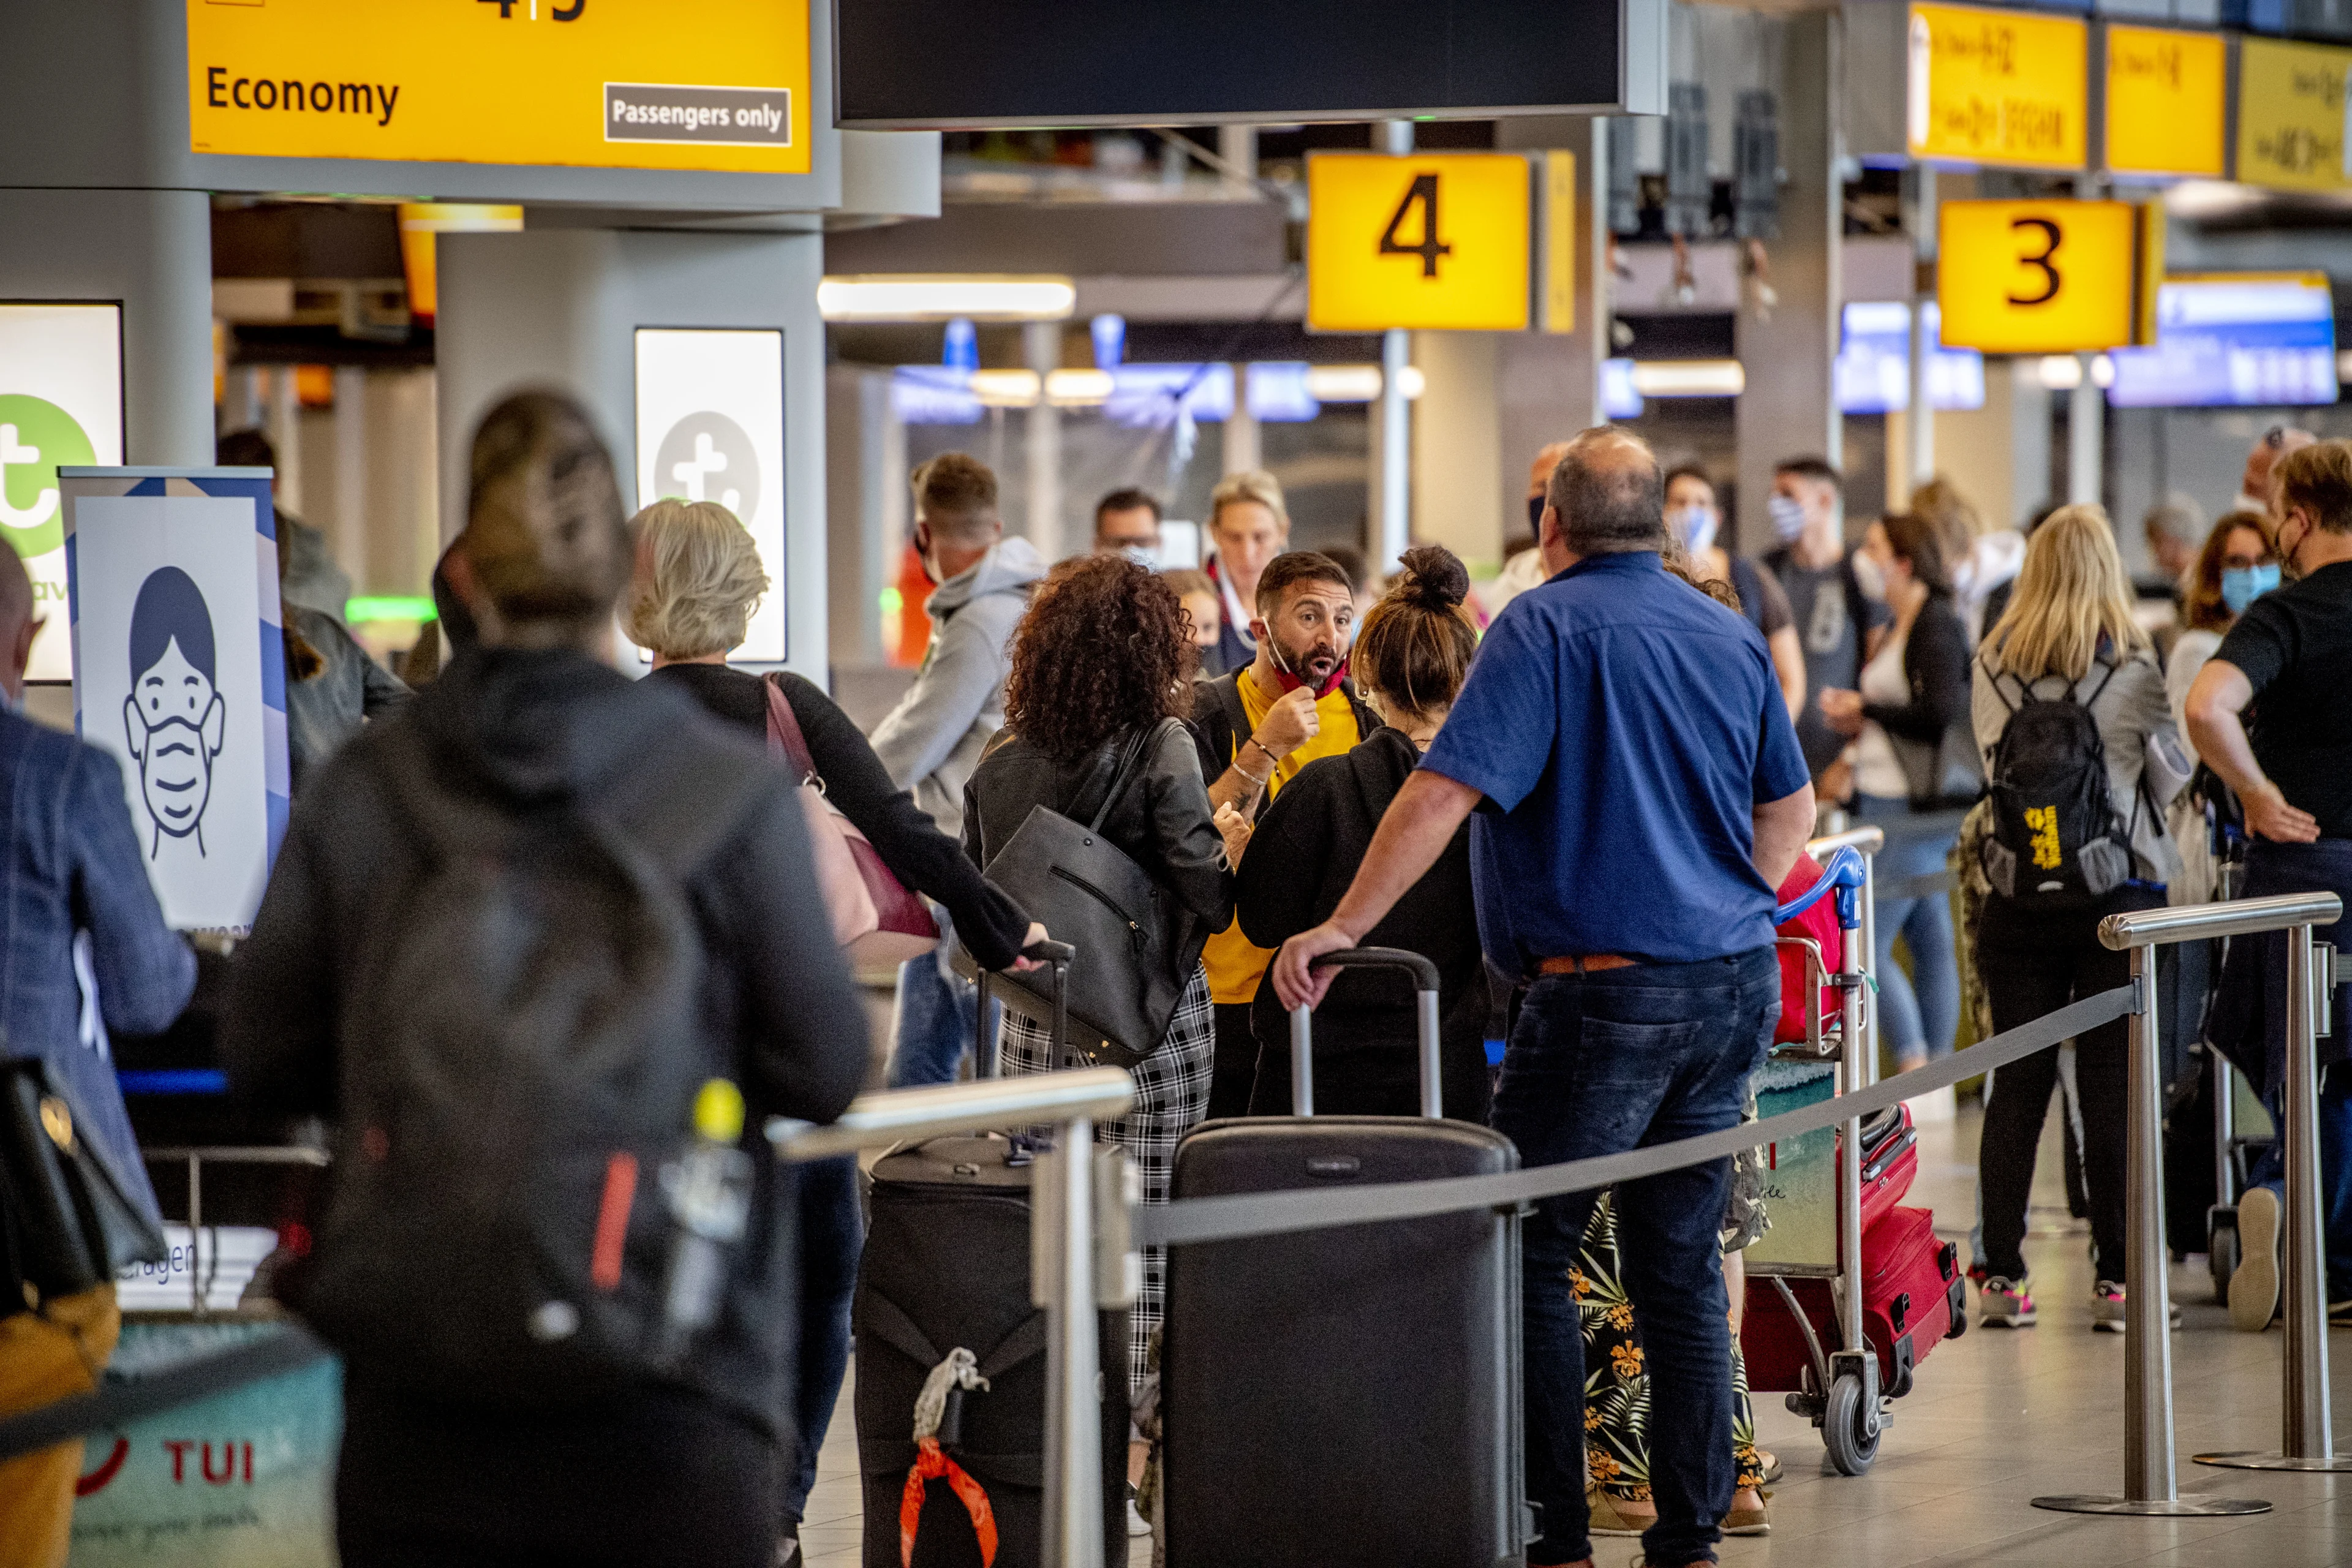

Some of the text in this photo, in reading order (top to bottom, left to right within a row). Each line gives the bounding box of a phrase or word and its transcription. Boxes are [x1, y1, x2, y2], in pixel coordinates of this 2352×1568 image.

[207, 66, 400, 127] Economy
[612, 99, 783, 134] Passengers only
[1379, 174, 1450, 277] 4
[2008, 218, 2062, 305] 3
[164, 1440, 254, 1487] TUI
